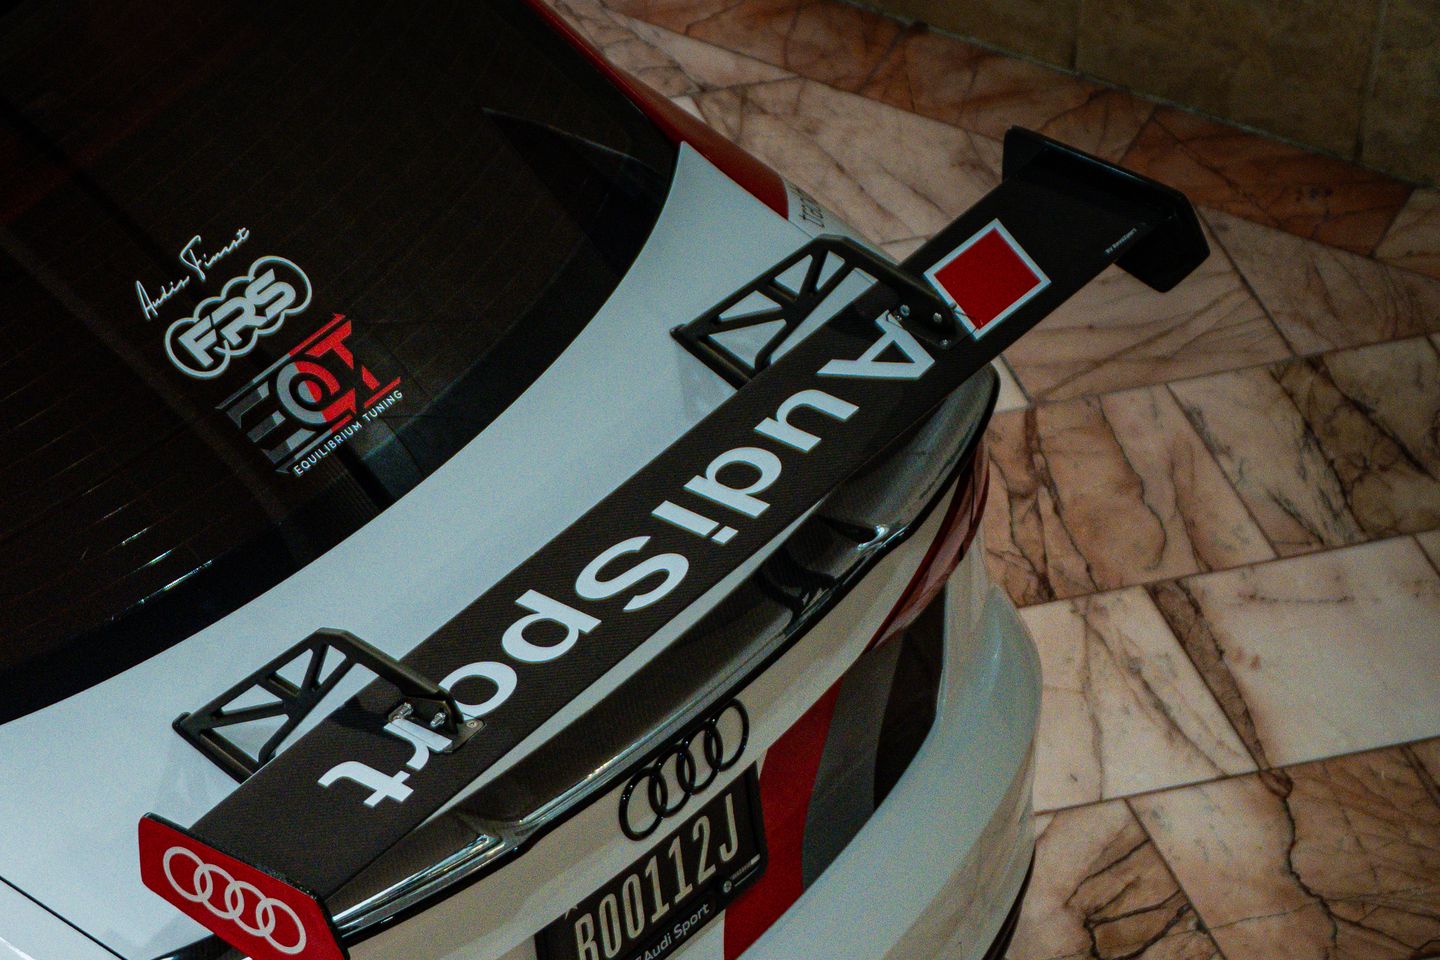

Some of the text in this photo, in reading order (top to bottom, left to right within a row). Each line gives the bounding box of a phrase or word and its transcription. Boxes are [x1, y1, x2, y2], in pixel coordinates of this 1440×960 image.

[176, 267, 297, 369] FRS
[292, 388, 404, 477] EQUILIBRIUM TUNING
[672, 902, 711, 940] Sport
